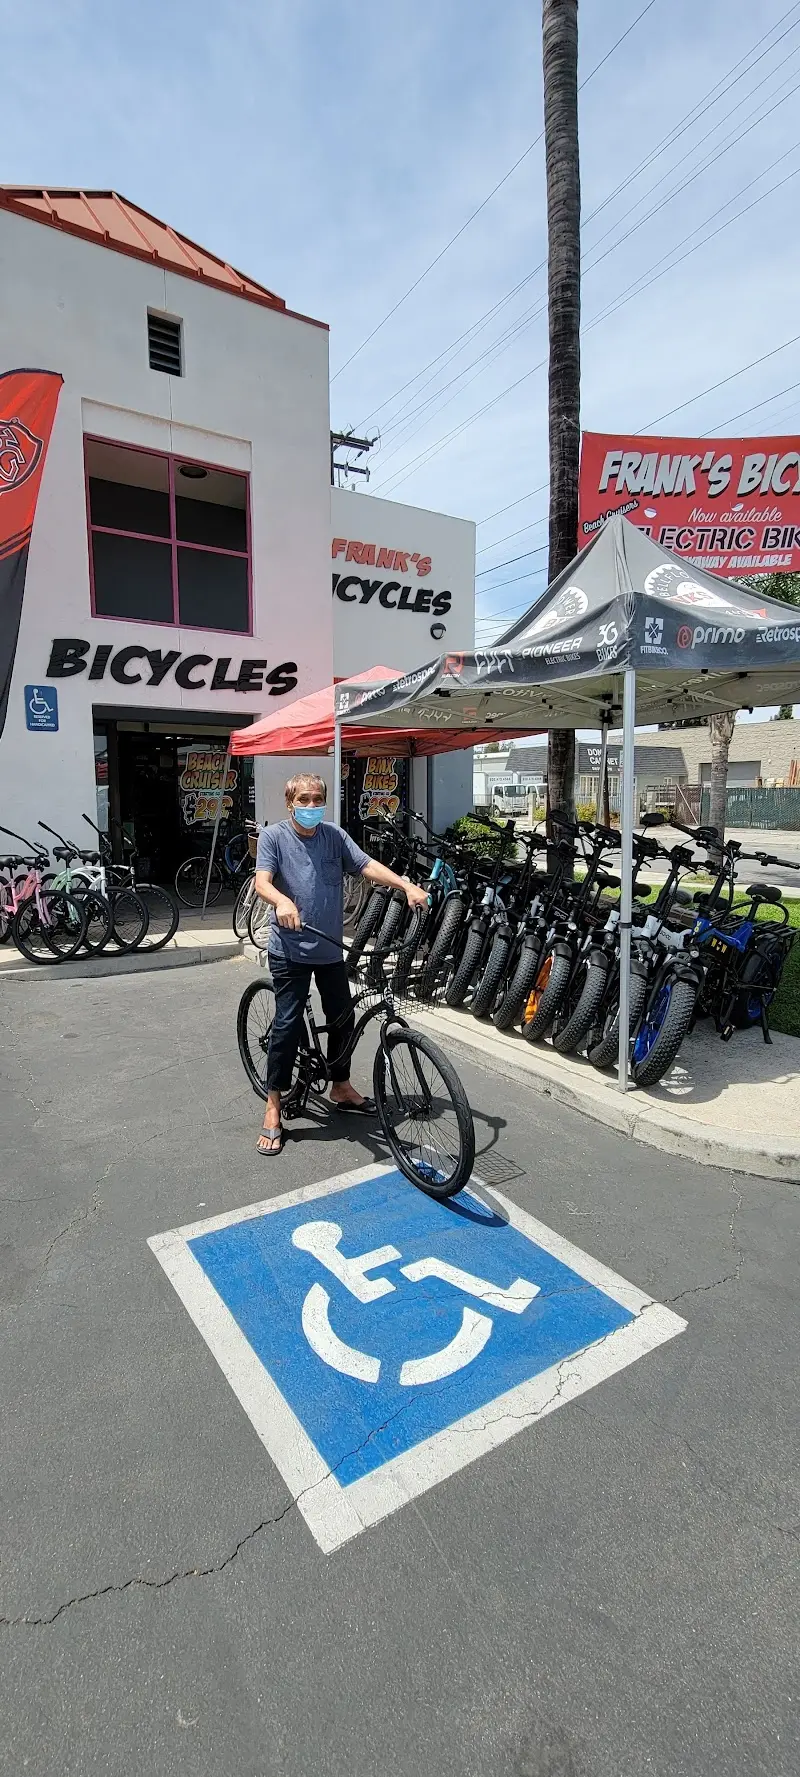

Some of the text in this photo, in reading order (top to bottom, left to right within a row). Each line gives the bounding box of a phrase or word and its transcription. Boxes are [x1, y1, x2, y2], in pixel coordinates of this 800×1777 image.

[598, 450, 733, 498] FRANK'S
[688, 506, 782, 523] Now available
[331, 537, 432, 577] FRANK'S
[727, 554, 793, 569] AVAILABLE
[597, 621, 619, 648] 3G
[691, 626, 746, 650] primo
[545, 652, 581, 665] ELECTRIC BIKES
[596, 645, 618, 662] BIKES
[46, 638, 298, 695] BICYCLES
[188, 752, 228, 771] BEACH
[368, 757, 395, 774] BMX
[363, 774, 397, 790] BIKES
